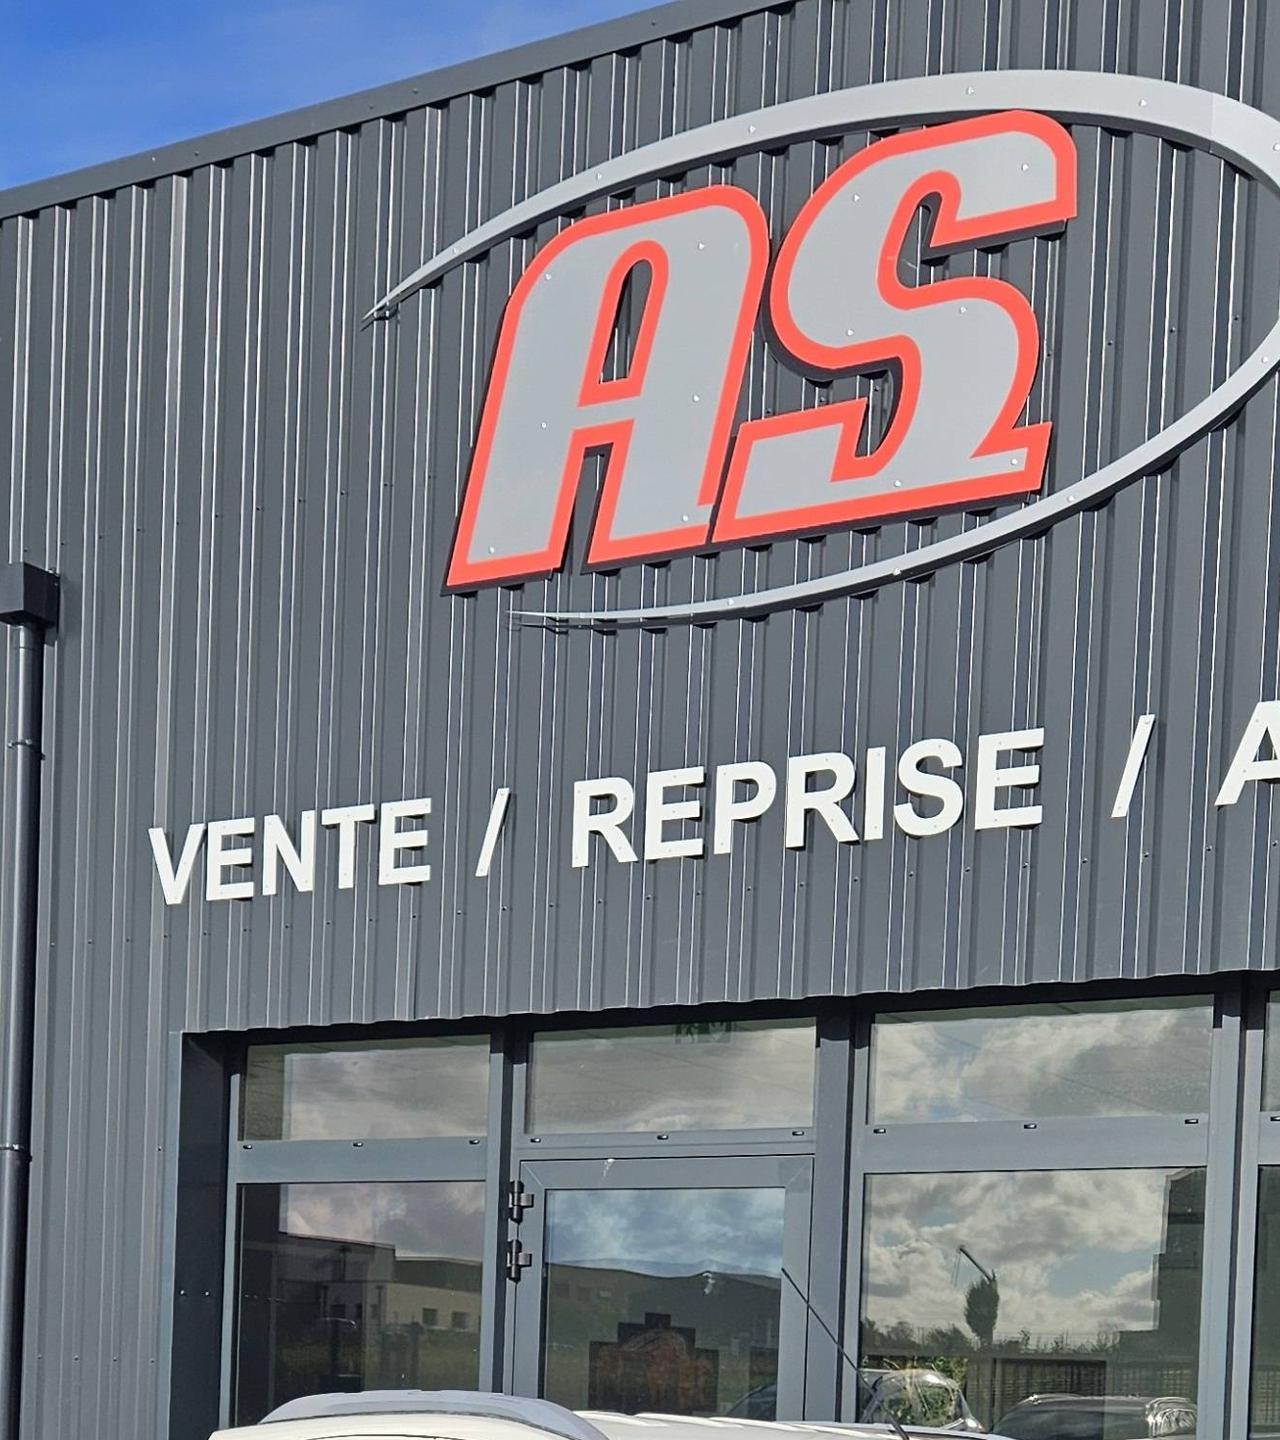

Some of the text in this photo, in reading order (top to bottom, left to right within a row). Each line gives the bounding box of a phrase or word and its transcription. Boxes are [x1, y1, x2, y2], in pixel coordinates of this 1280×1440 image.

[445, 109, 1078, 587] AS
[148, 798, 432, 905] VENTE
[475, 787, 510, 877] /
[572, 727, 1045, 868] REPRISE
[1111, 714, 1155, 818] /
